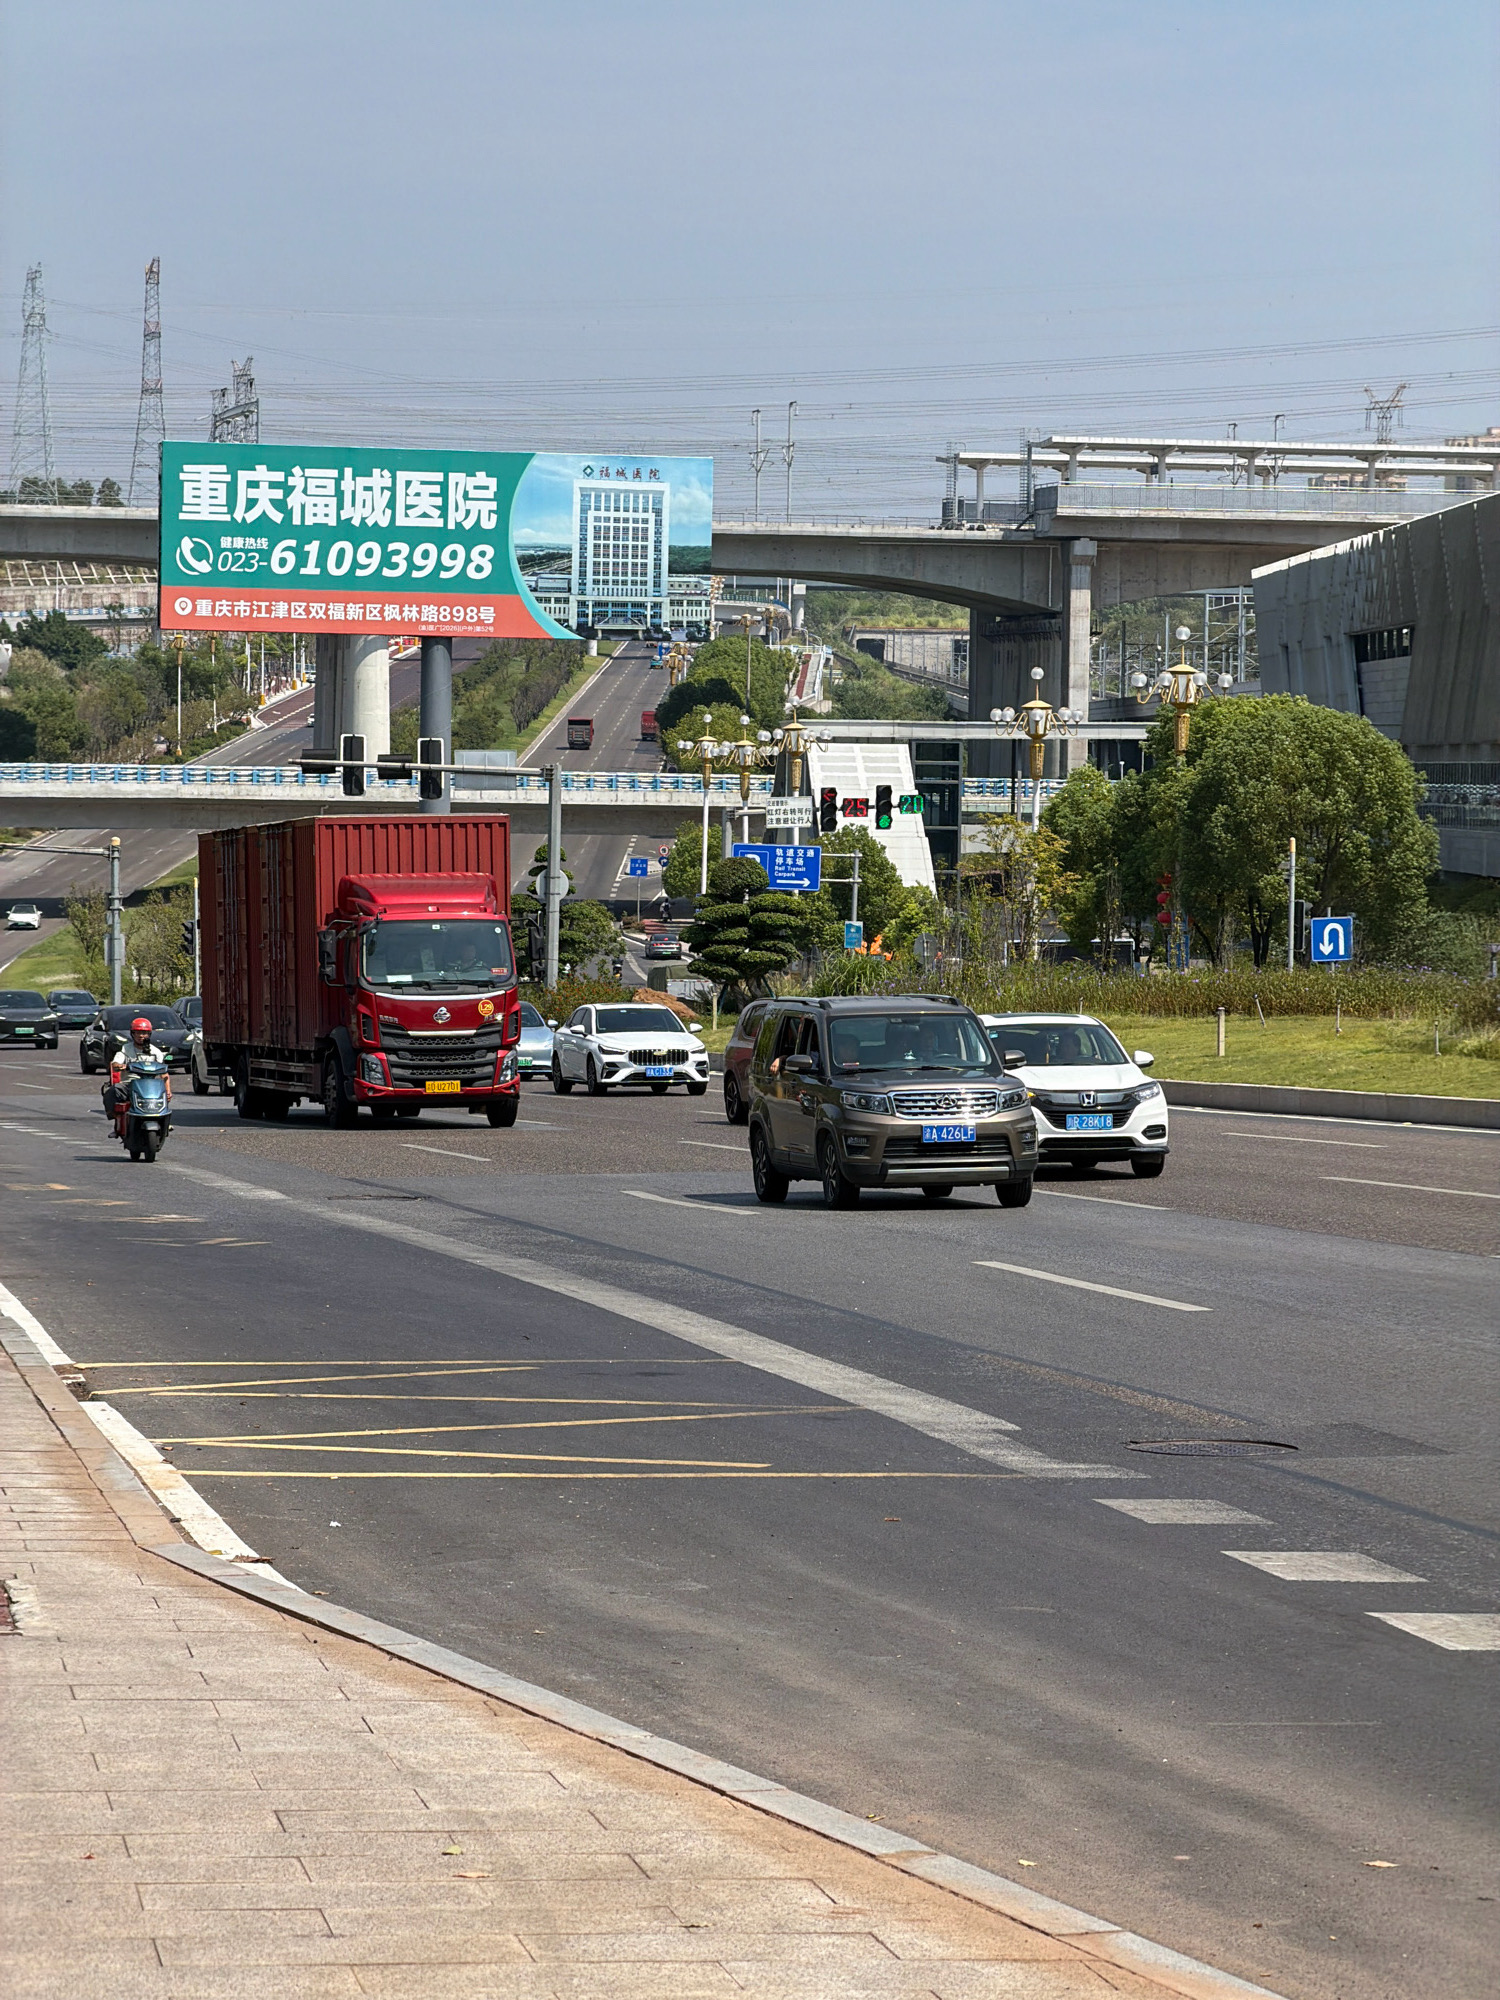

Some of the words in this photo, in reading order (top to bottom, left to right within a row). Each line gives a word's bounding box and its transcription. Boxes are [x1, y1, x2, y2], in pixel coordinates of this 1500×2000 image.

[599, 466, 660, 480] 福城医院
[178, 464, 498, 531] 重庆福城医院
[220, 536, 269, 550] 健康热线
[217, 538, 495, 580] 023-61093998
[194, 599, 496, 624] 重庆市江津区双福新区枫林路898号
[767, 807, 812, 816] 红灯右转可行
[844, 798, 867, 817] 25
[901, 795, 924, 814] 20
[767, 816, 812, 825] 注意避让行人
[775, 848, 815, 857] 轨道交通
[775, 857, 804, 866] 停车场
